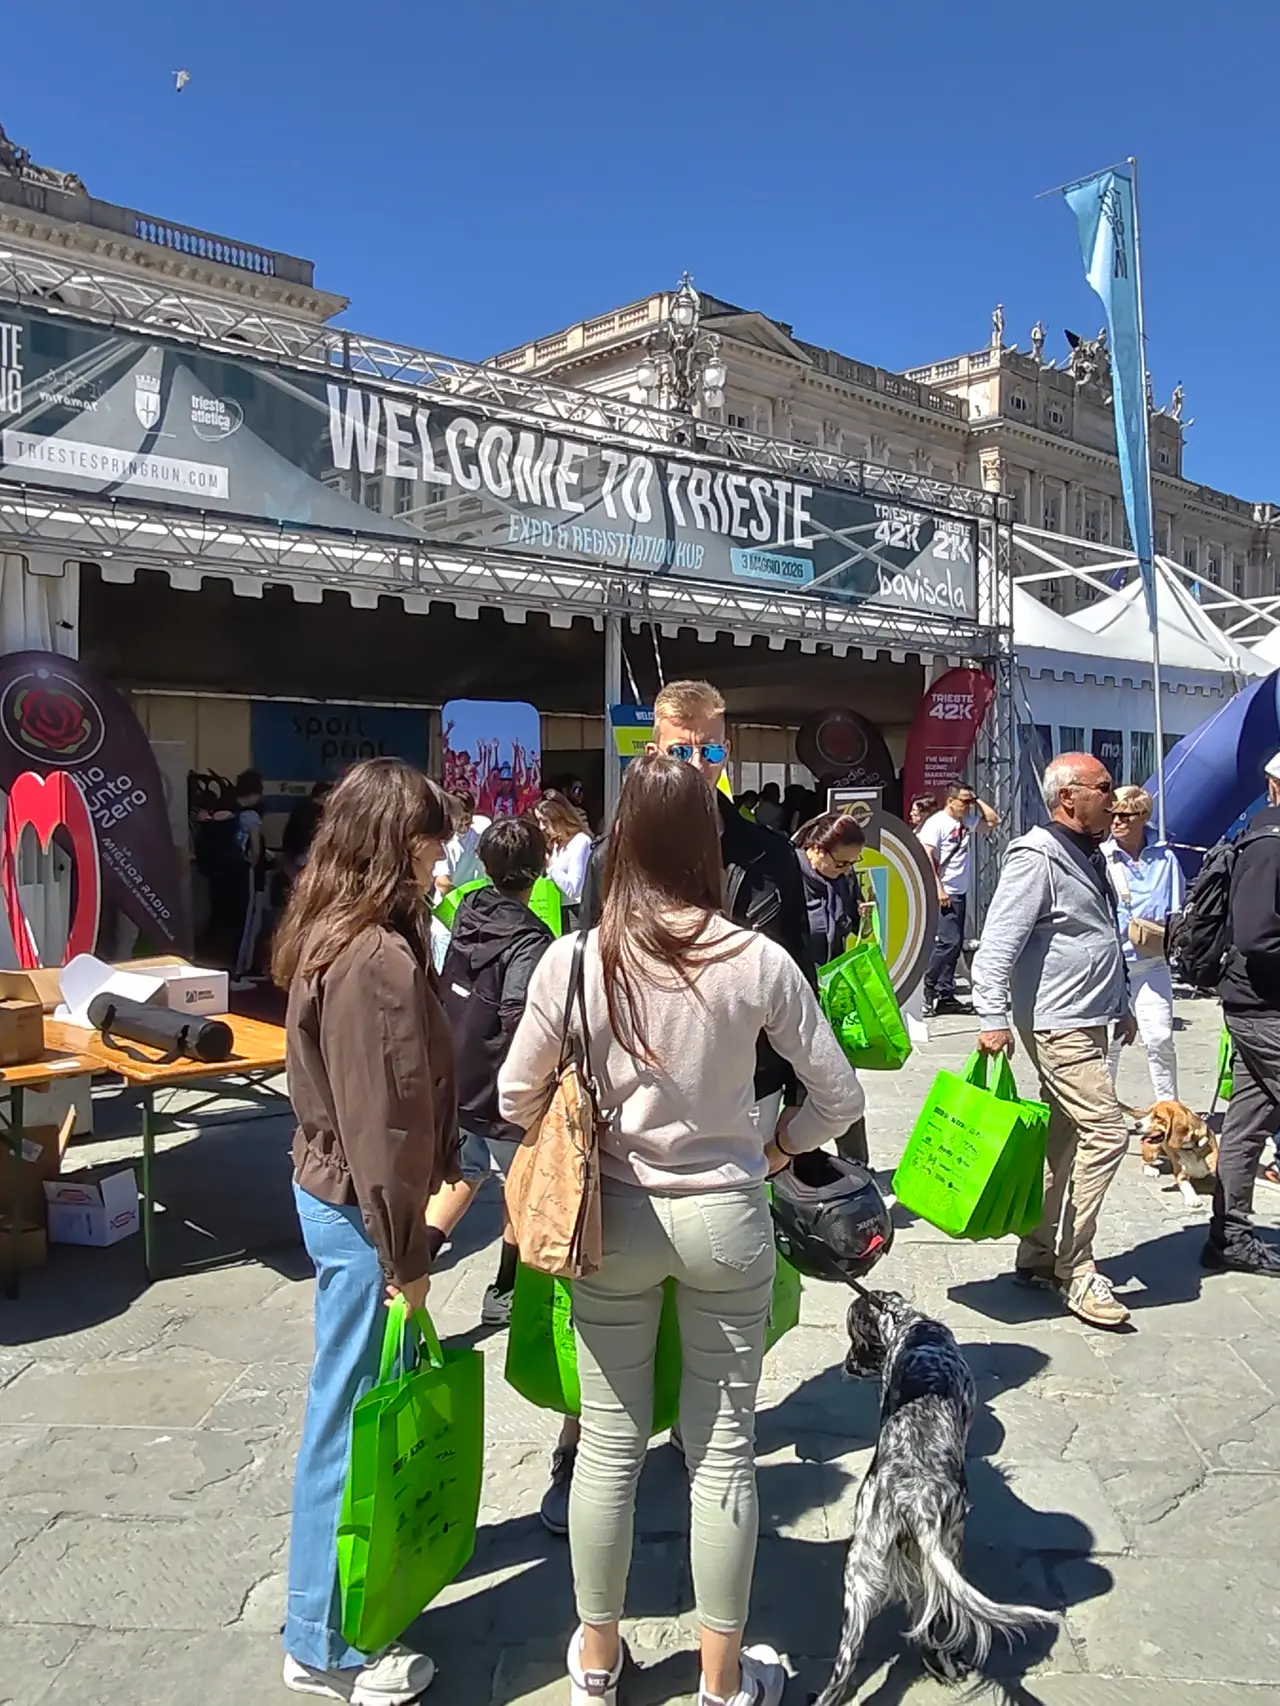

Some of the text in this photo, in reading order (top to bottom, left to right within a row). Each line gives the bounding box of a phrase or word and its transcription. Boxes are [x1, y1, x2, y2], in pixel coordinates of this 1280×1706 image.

[39, 391, 99, 412] miramar
[192, 395, 225, 413] trieste
[191, 410, 230, 428] atletica
[16, 440, 219, 489] TRIESTESPRINGRUN.COM
[327, 384, 815, 550] WELCOME TO TRIESTE
[874, 503, 921, 526] TRIESTE
[874, 520, 921, 552] 42K
[933, 517, 971, 537] TRIESTE
[508, 514, 705, 570] EXPO & REGISTRATION HUB
[741, 555, 748, 569] 3
[781, 561, 804, 578] 2026
[931, 693, 974, 703] TRIESTE
[929, 703, 973, 720] 42K
[292, 715, 365, 742] sport
[88, 775, 132, 811] unto
[101, 837, 171, 919] MIGLIOR RADIO
